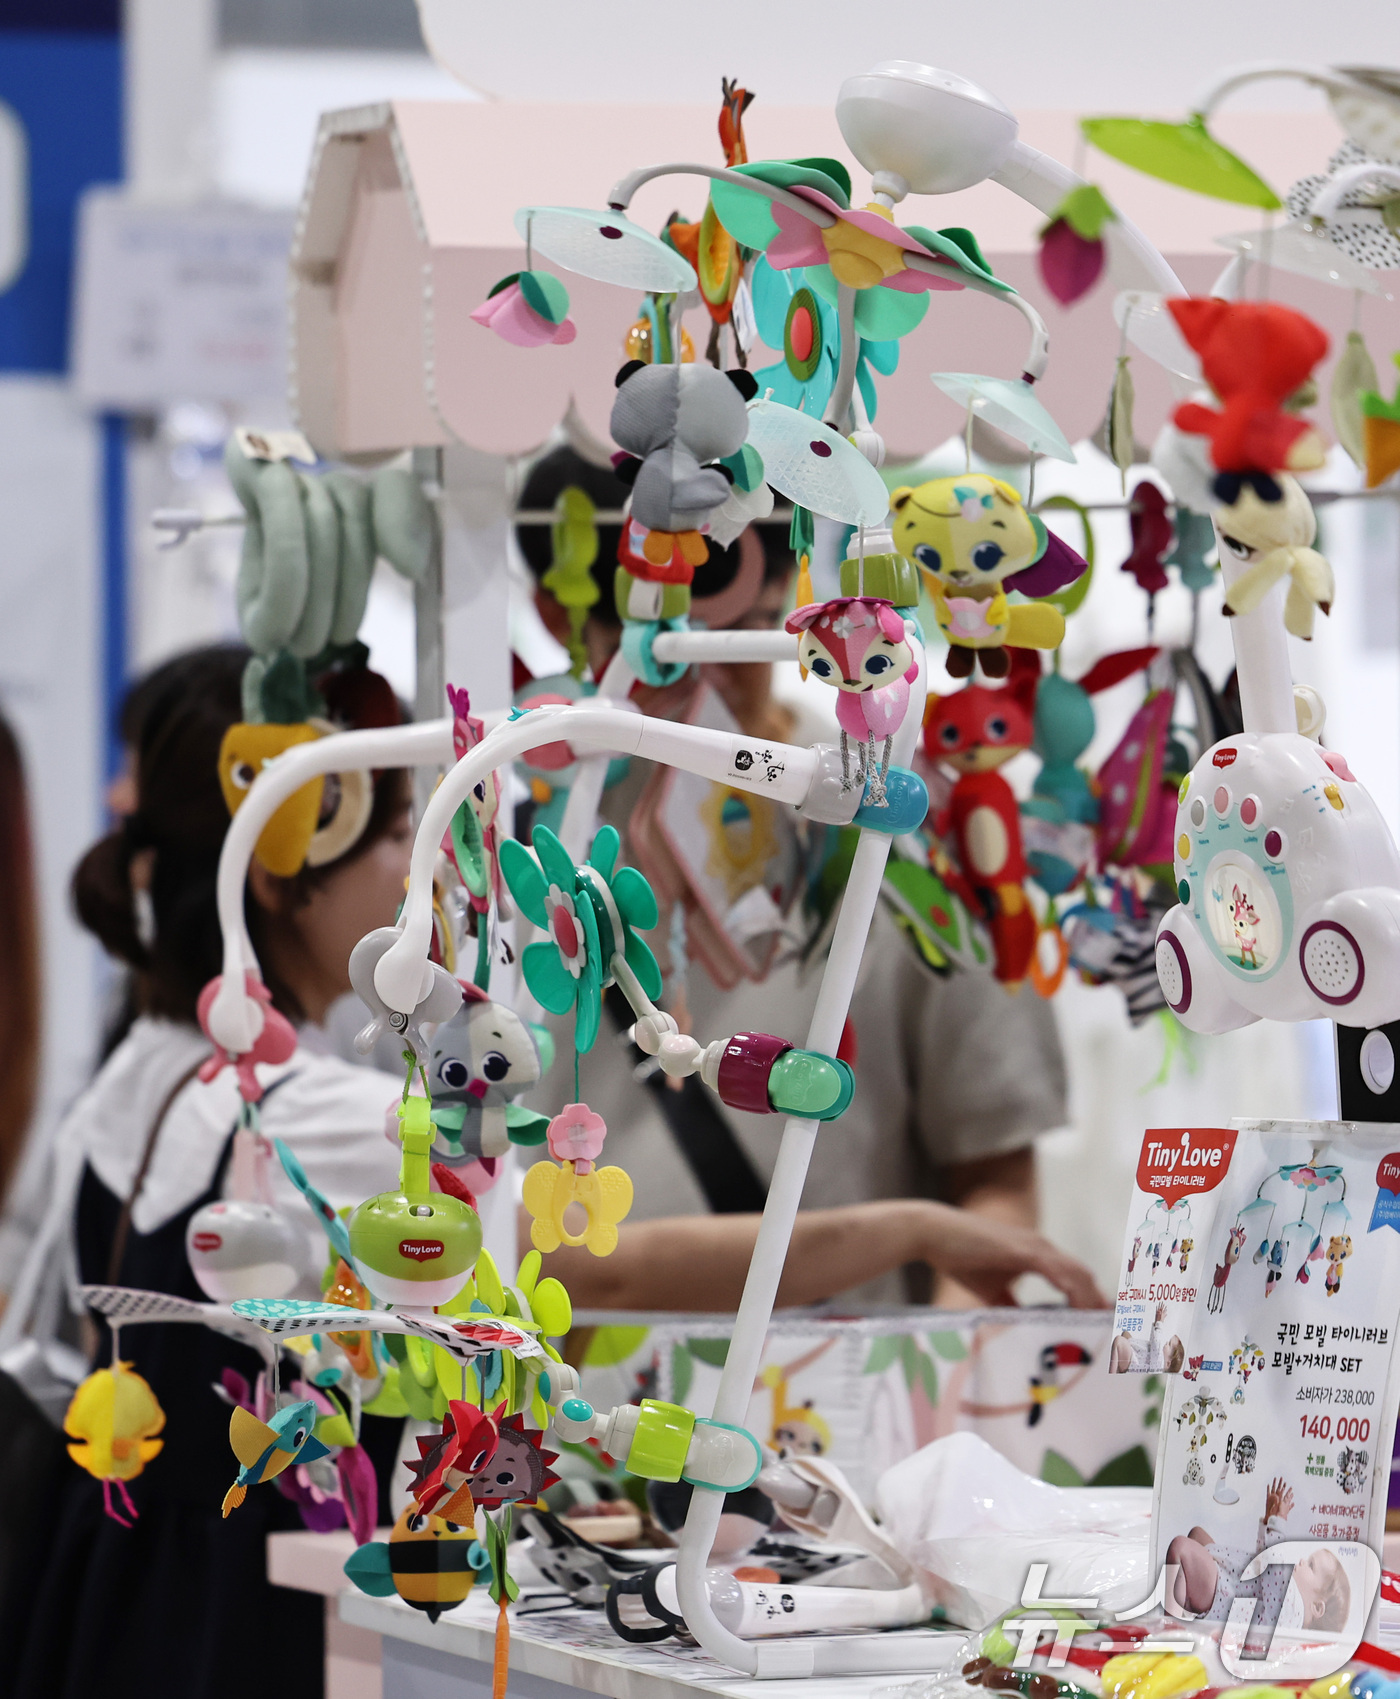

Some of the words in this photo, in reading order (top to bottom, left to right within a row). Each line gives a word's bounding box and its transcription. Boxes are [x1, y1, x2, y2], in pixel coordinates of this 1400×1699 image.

[1173, 1175, 1206, 1186] 타이니러브
[1277, 1323, 1300, 1345] 국민
[1304, 1324, 1327, 1348] 모빌
[1331, 1325, 1388, 1344] 타이니러브
[1271, 1351, 1338, 1375] 모빌+거치대
[1340, 1357, 1363, 1373] SET
[1295, 1386, 1333, 1404] 소비자가
[1334, 1388, 1375, 1407] 238,000
[1300, 1414, 1371, 1445] 140,000
